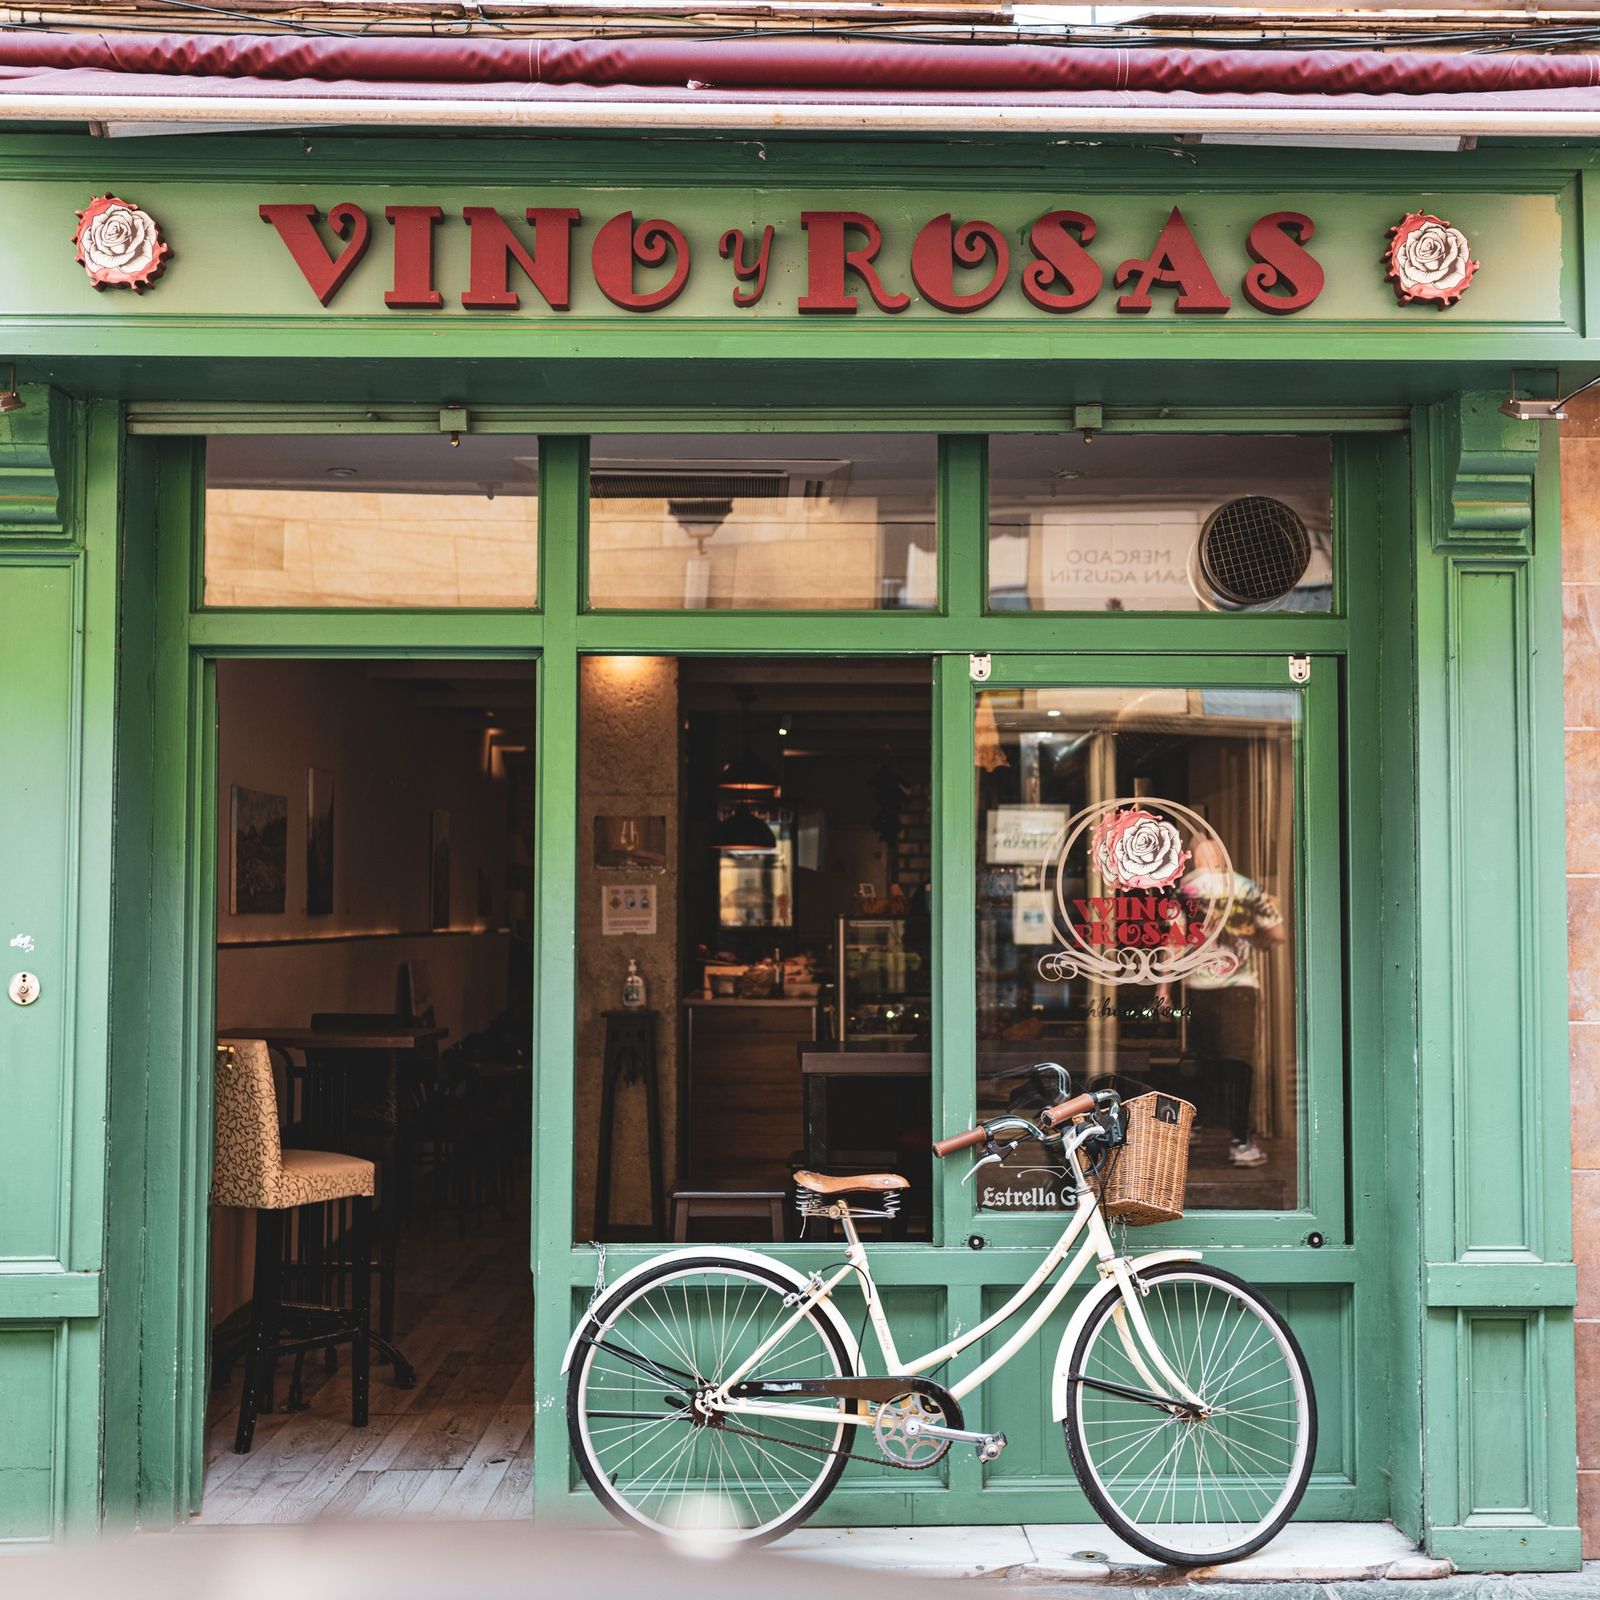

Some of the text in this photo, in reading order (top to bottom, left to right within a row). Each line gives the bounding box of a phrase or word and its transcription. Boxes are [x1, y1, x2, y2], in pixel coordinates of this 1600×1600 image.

[259, 202, 690, 312] VINO
[798, 205, 1324, 315] ROSAS
[1085, 896, 1182, 921] VINO
[1089, 920, 1206, 945] ROSAS
[982, 1187, 1057, 1206] Estrella
